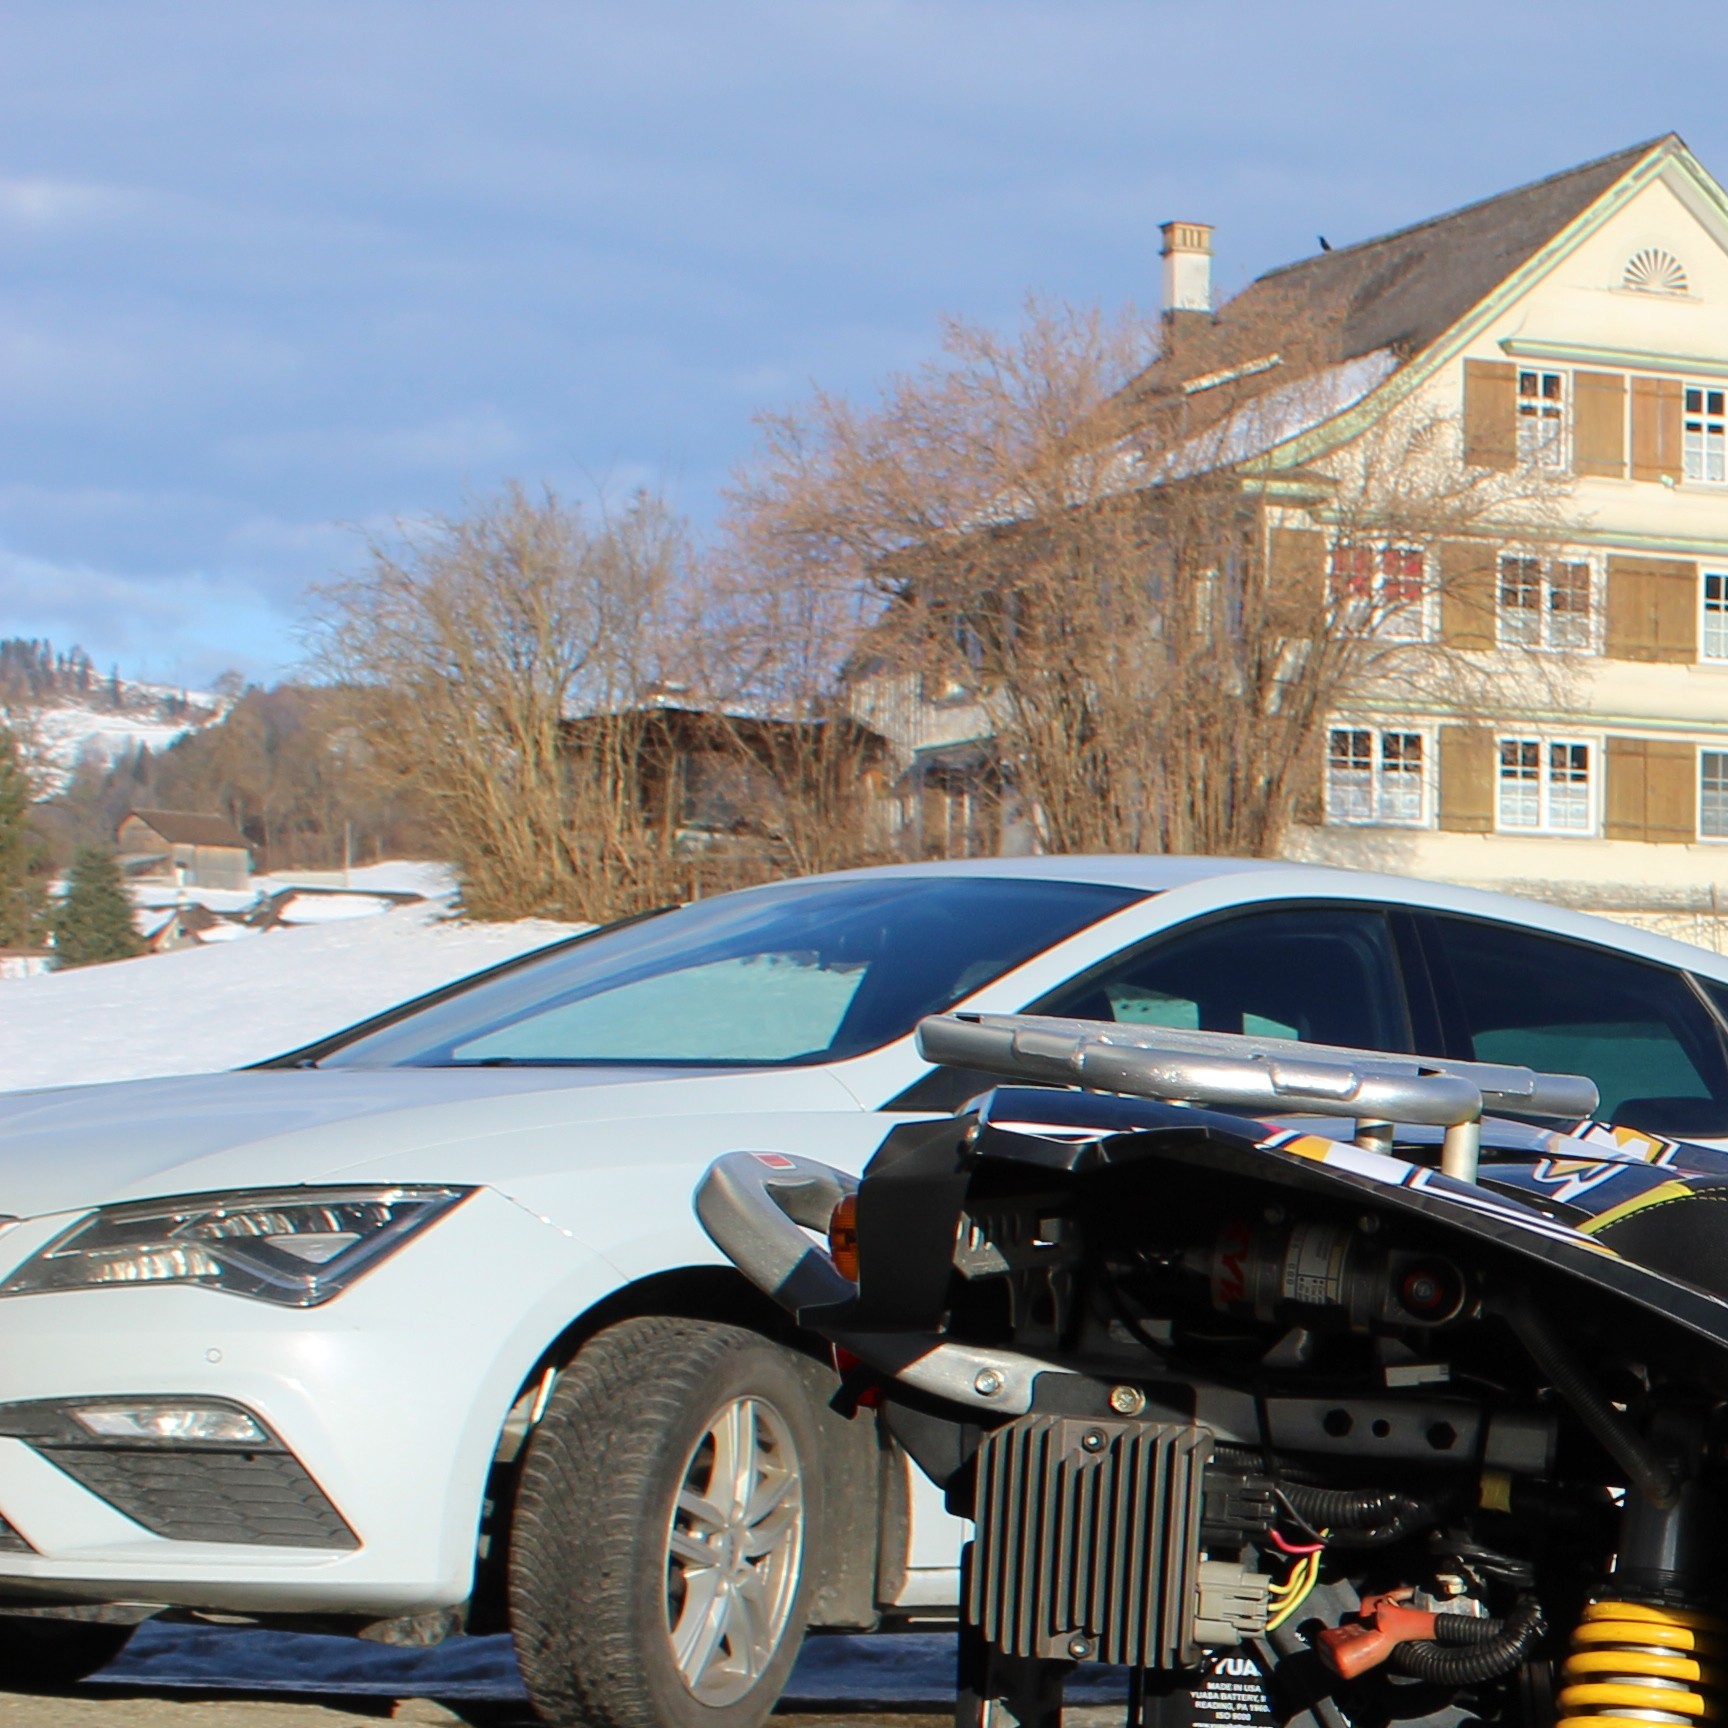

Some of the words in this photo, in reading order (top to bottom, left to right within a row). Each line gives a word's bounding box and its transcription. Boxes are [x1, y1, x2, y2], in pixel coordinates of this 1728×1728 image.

[1206, 1682, 1233, 1692] MADE
[1233, 1683, 1242, 1692] IN
[1243, 1684, 1262, 1693] USA
[1190, 1691, 1220, 1700] YUASA
